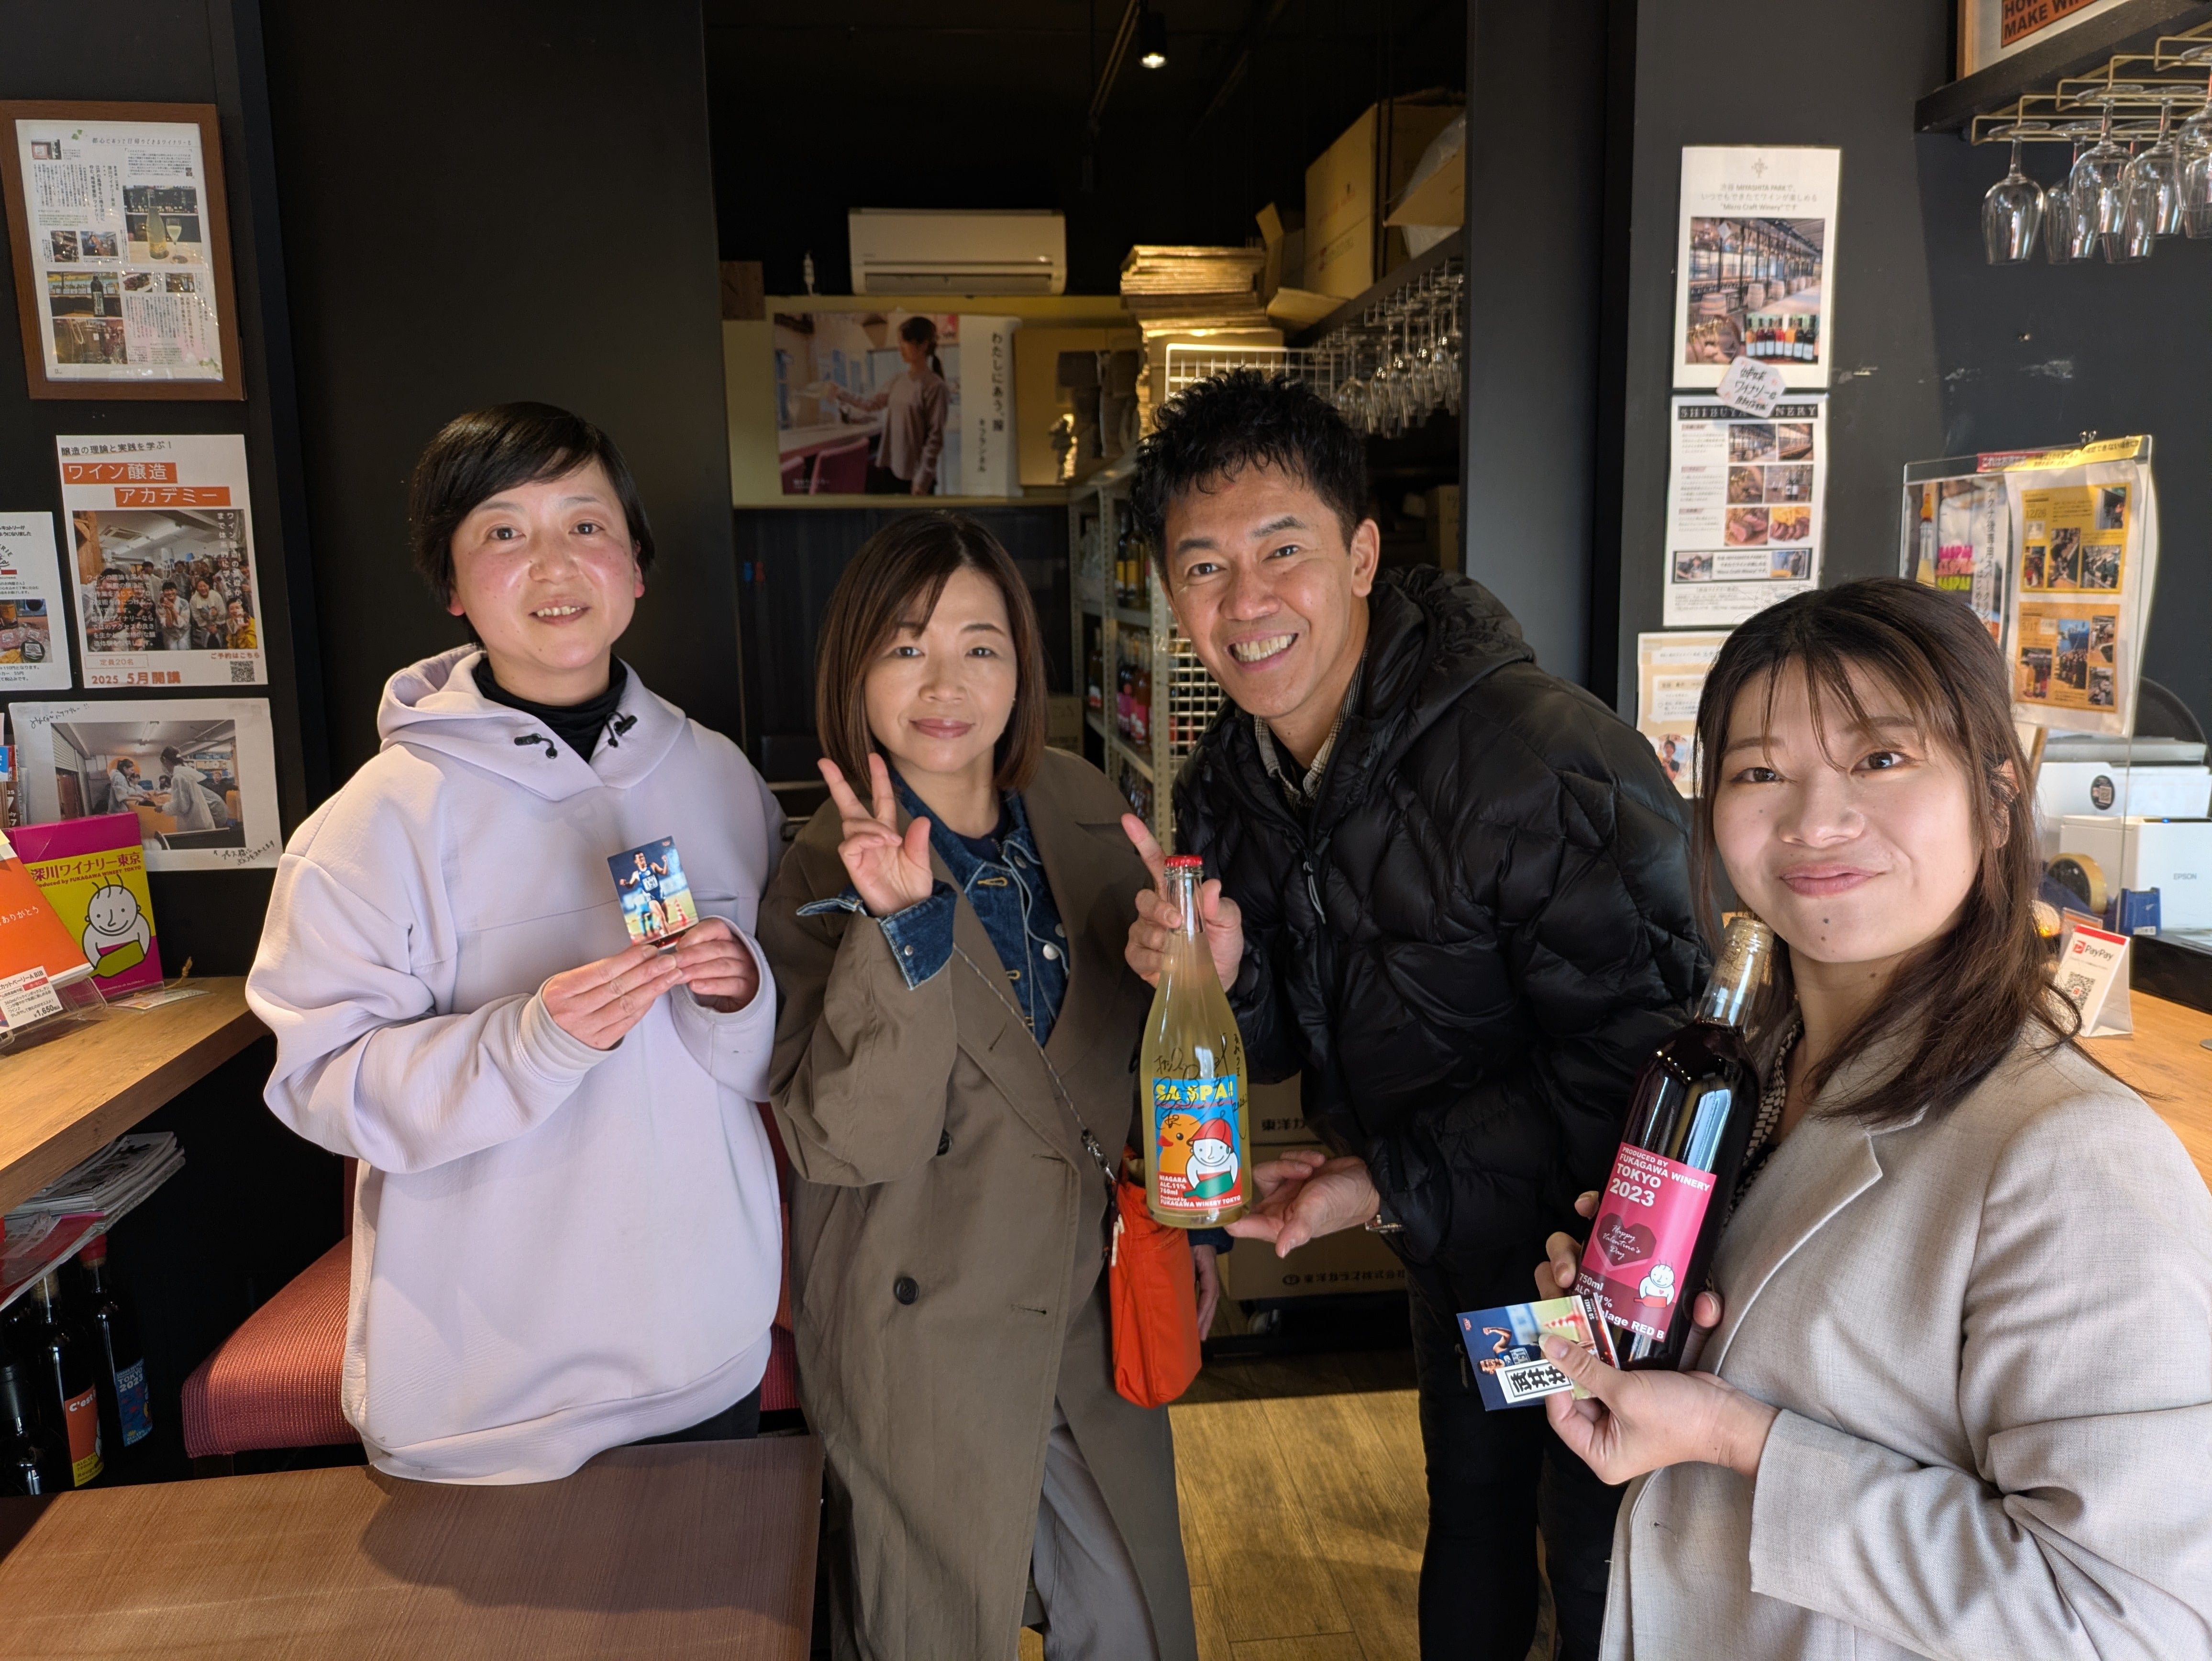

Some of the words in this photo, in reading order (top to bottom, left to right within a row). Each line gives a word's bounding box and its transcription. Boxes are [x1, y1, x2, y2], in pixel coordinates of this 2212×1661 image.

[2004, 0, 2037, 20] HO
[2004, 4, 2048, 39] MAKE
[68, 463, 167, 480] ワイン醸造
[120, 487, 217, 503] アカデミー
[91, 675, 119, 685] 2025
[126, 670, 182, 685] 5月開講
[31, 852, 141, 882] 深川ワイナリー東京
[69, 874, 102, 883] FUKAGAWA
[2085, 944, 2113, 960] PayPay
[0, 972, 34, 991] カットベーリーA
[34, 970, 44, 979] BIB
[1622, 1147, 1656, 1163] PRODUCED
[1658, 1158, 1669, 1167] BY
[1159, 1174, 1187, 1183] NIAGARA
[1616, 1163, 1661, 1188] TOKYO
[1619, 1153, 1669, 1177] FUKAGAWA
[1671, 1171, 1711, 1192] WINERY
[1160, 1182, 1186, 1190] ALC.11%
[1609, 1177, 1656, 1207] 2023
[1160, 1199, 1195, 1207] FUKAGAWA
[1222, 1195, 1241, 1205] TOKYO
[1602, 1232, 1641, 1254] Valentine's
[1612, 1224, 1636, 1244] Happy
[1609, 1245, 1625, 1260] Day
[1579, 1273, 1604, 1292] 750ml
[1626, 1320, 1655, 1336] RED
[118, 1367, 142, 1384] TOKYO
[69, 1394, 93, 1412] C'est
